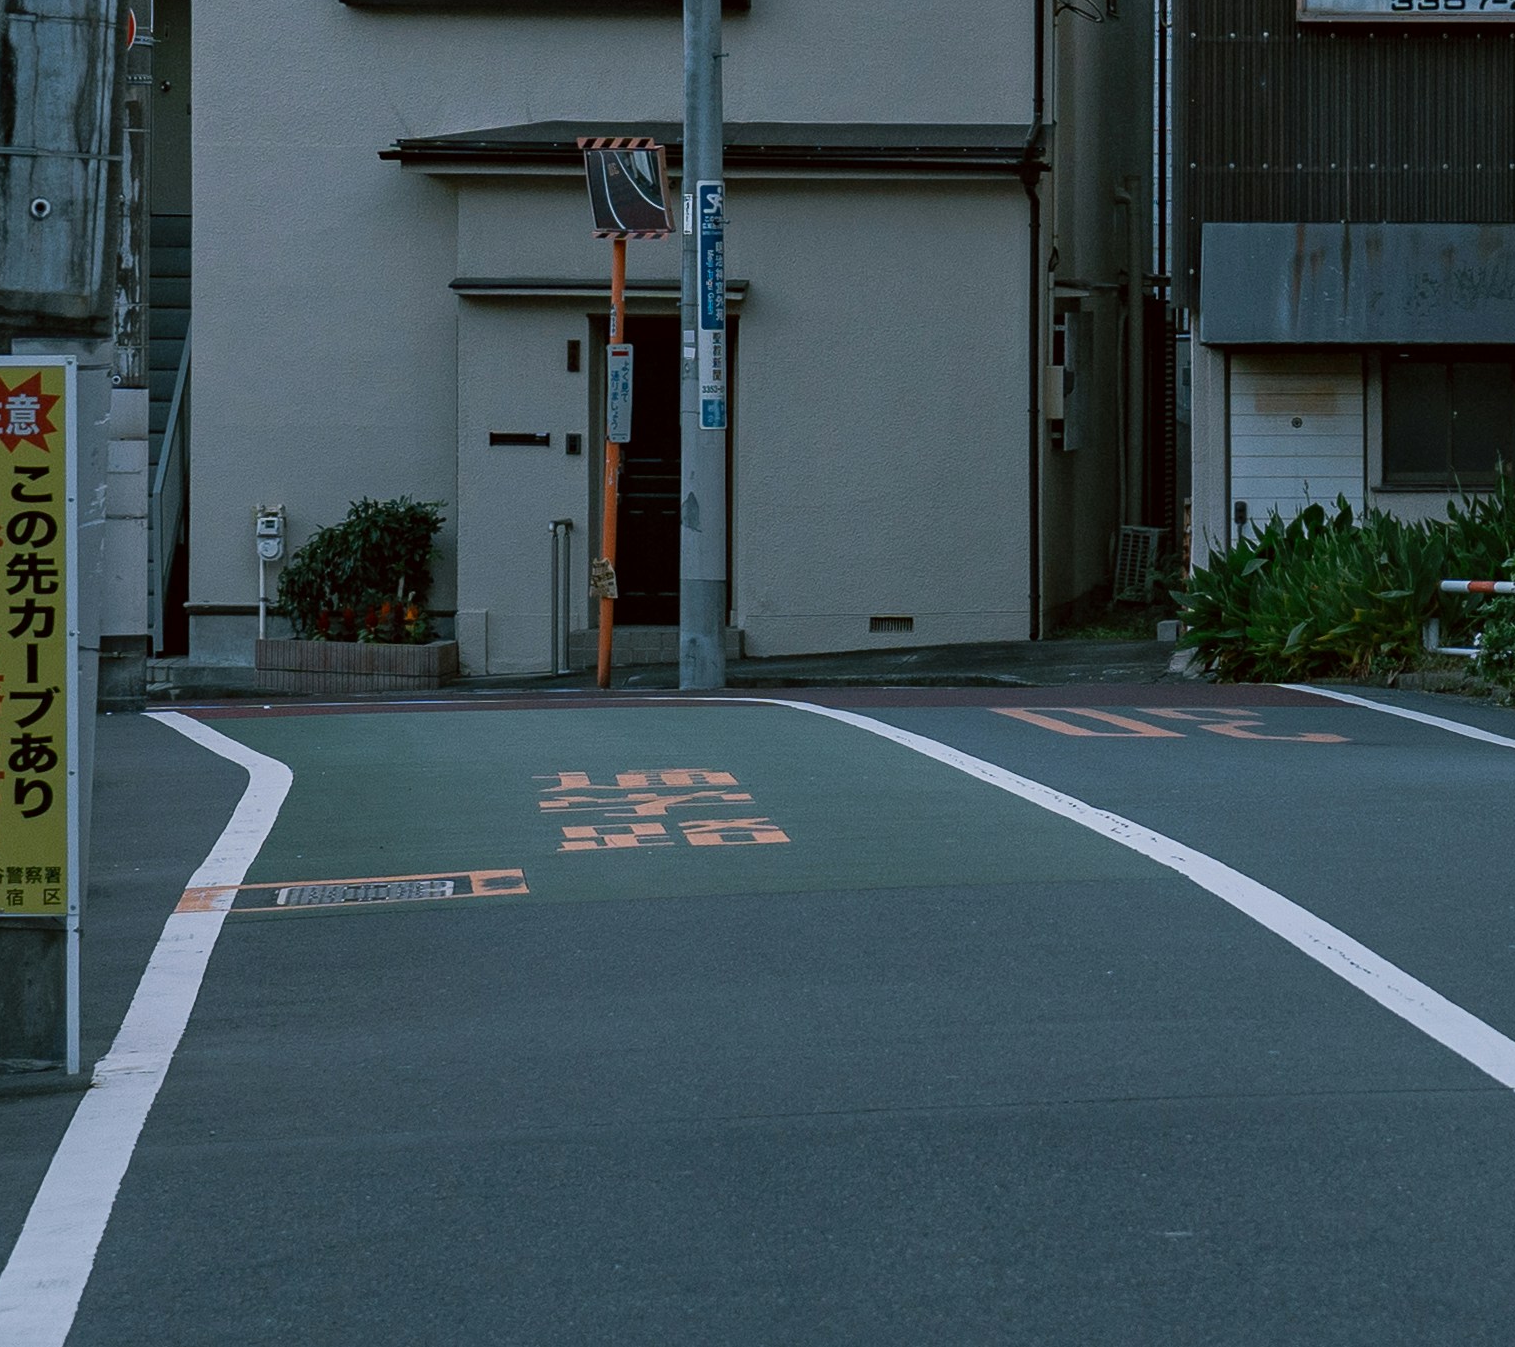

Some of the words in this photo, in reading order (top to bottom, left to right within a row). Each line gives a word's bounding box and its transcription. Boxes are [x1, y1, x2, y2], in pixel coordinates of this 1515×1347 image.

[6, 464, 62, 819] この先カーブあり
[986, 707, 1353, 743] 30
[530, 768, 791, 852] 通学路
